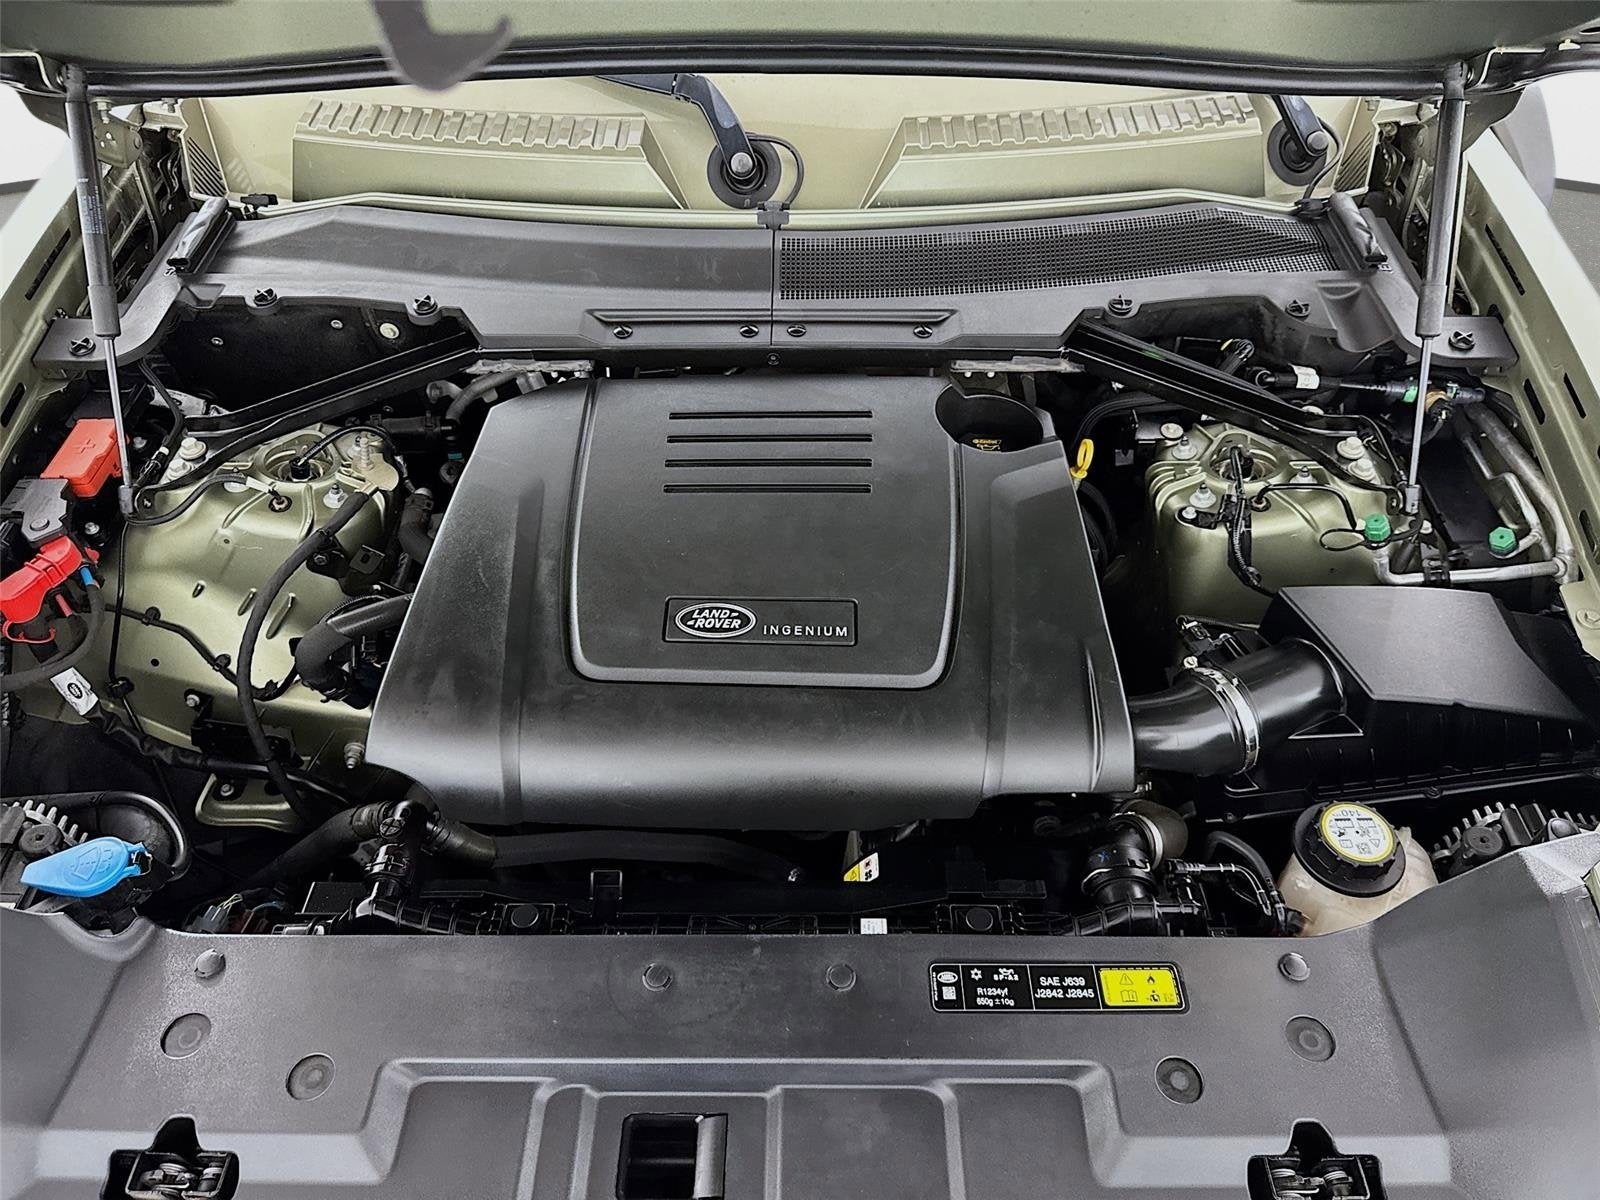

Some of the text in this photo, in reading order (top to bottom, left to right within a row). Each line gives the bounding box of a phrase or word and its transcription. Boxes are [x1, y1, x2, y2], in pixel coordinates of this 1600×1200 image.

[692, 609, 732, 619] LAND
[694, 618, 742, 629] ROVER
[762, 625, 848, 637] INGENIUM
[1039, 976, 1086, 987] SAE J639
[976, 987, 1009, 997] R1234yf
[1034, 988, 1095, 998] J2842 J2845
